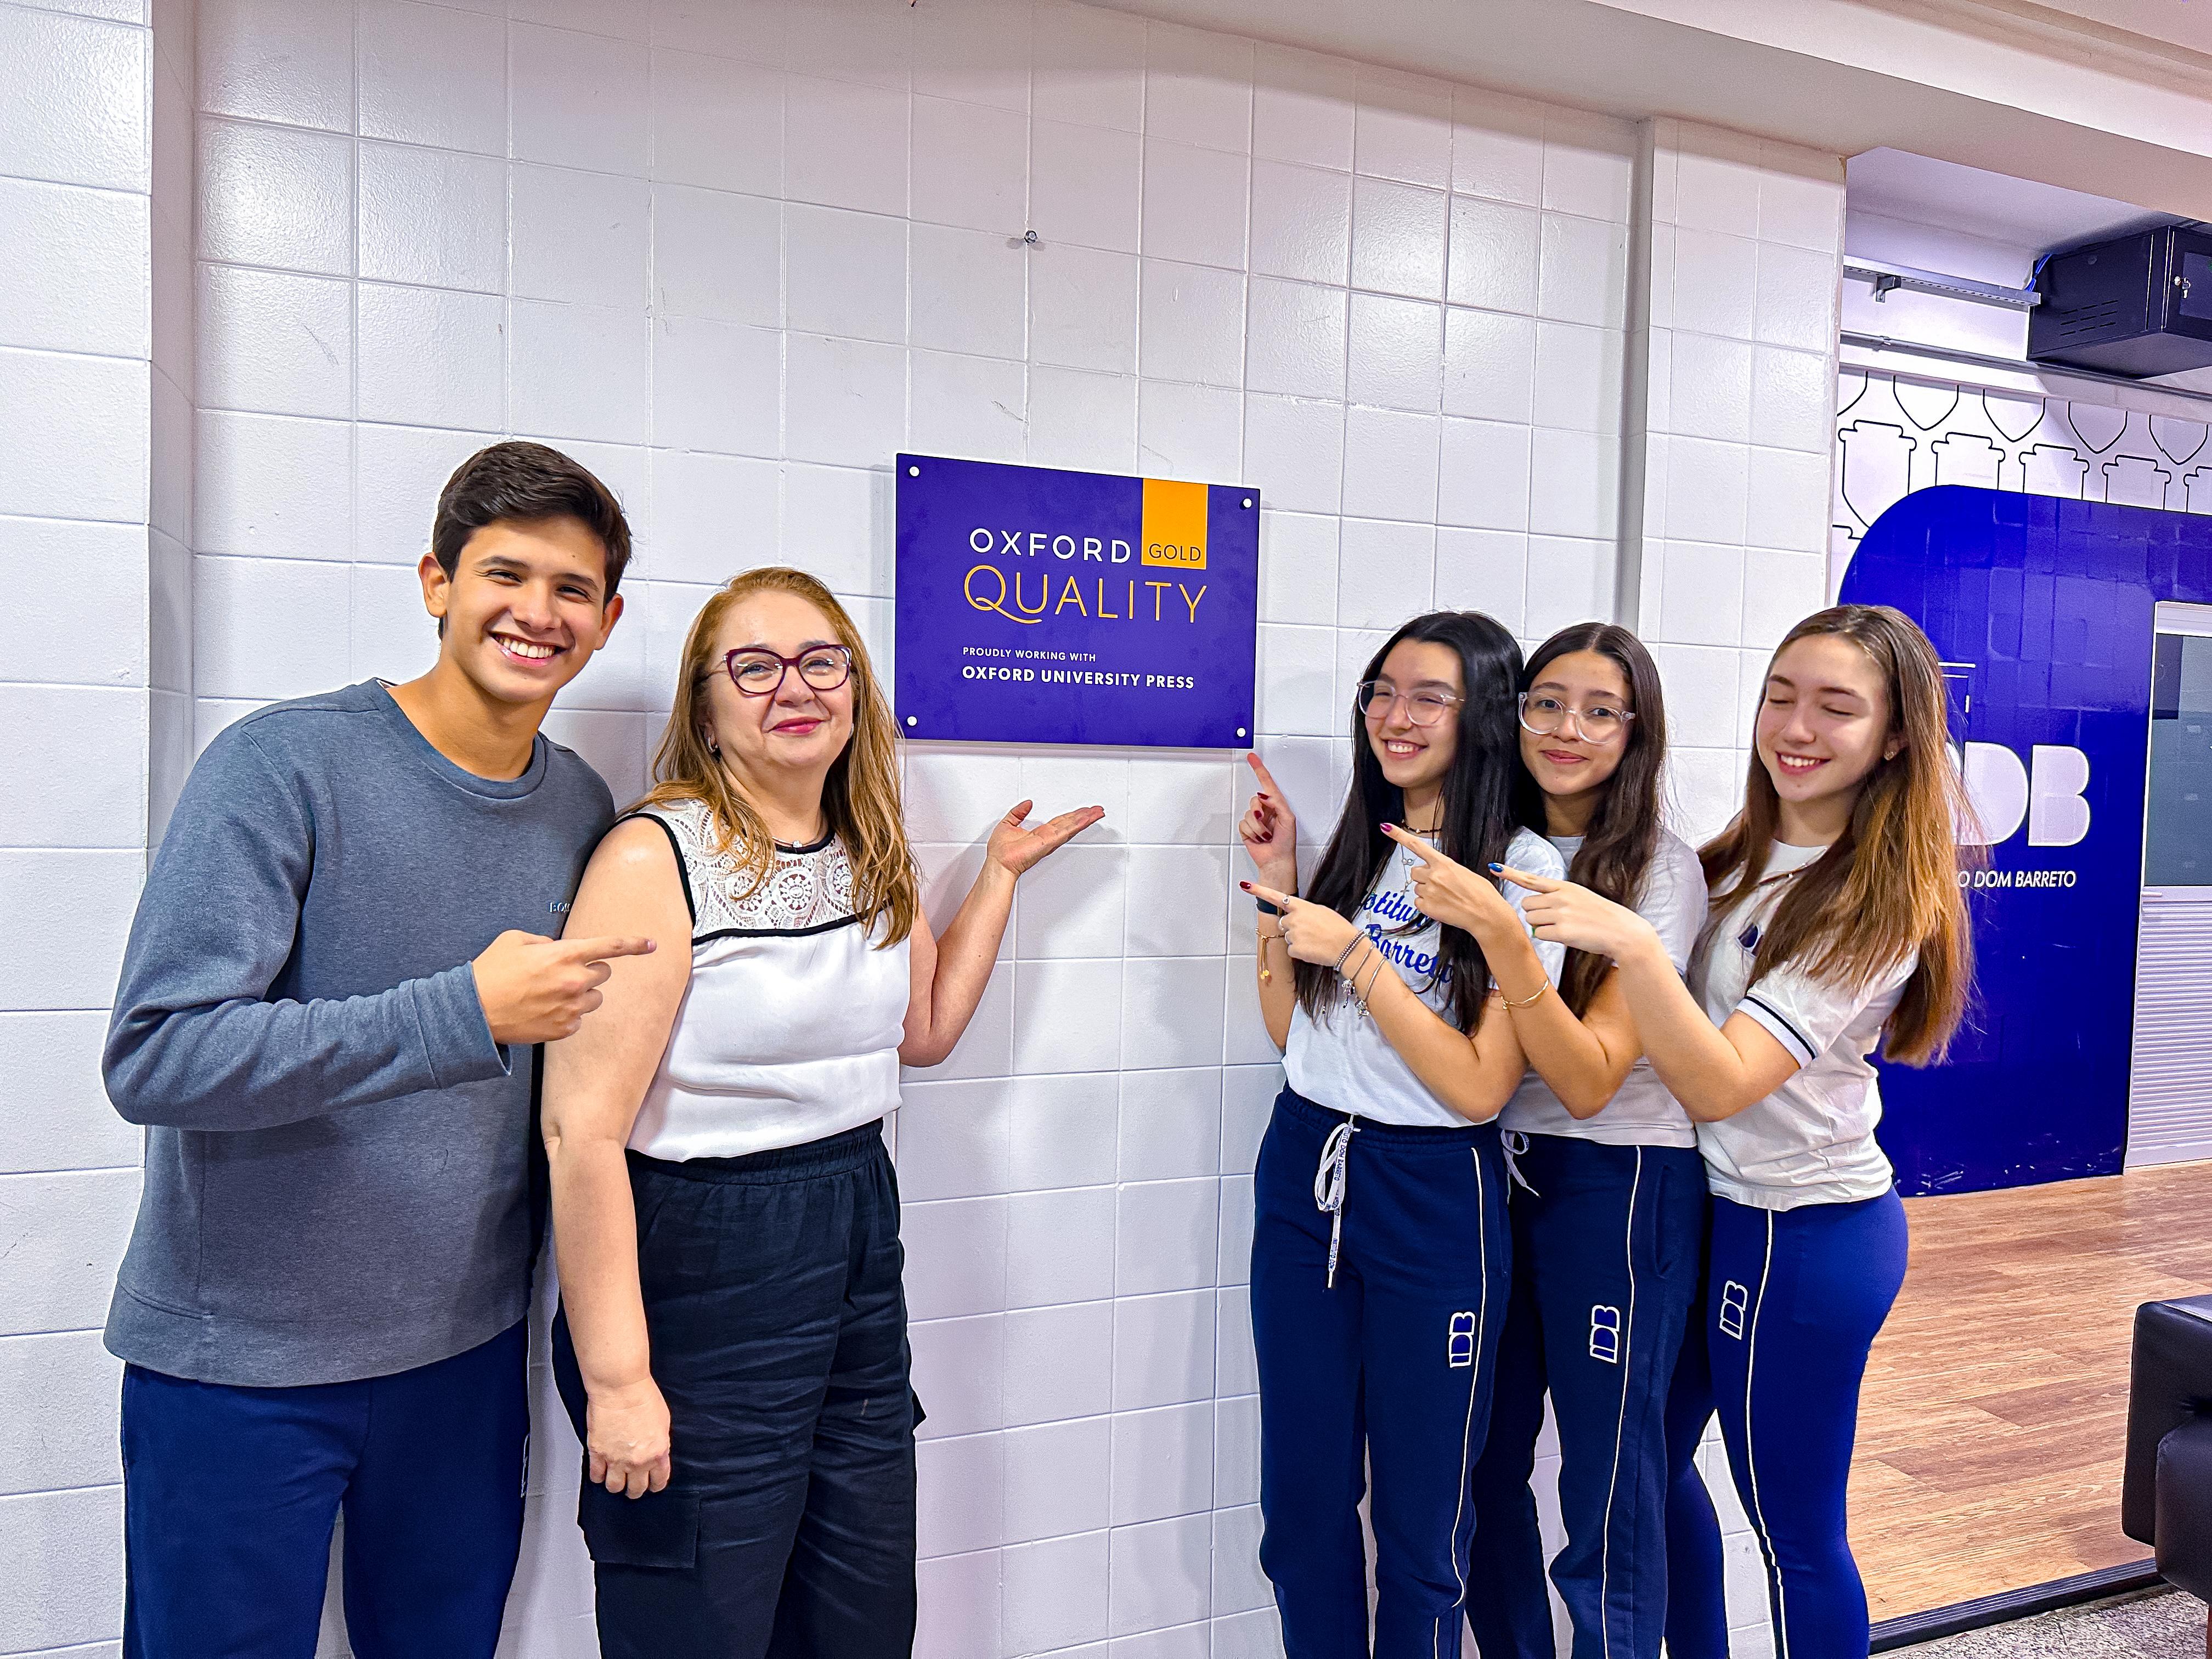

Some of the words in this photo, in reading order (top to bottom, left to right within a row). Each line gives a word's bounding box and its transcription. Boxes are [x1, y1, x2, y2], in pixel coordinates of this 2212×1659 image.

[969, 528, 1131, 563] OXFORD
[1148, 543, 1201, 562] GOLD
[964, 565, 1207, 624] QUALITY
[962, 647, 1011, 658] PROUDLY
[1015, 649, 1066, 661] WORKING
[1069, 651, 1096, 662] WITH
[962, 665, 1035, 682] OXFORD
[1041, 669, 1140, 687] UNIVERSITY
[1146, 675, 1194, 689] PRESS
[1945, 741, 2091, 847] DB
[1974, 870, 2011, 888] DOM
[2015, 870, 2076, 888] BARRETO
